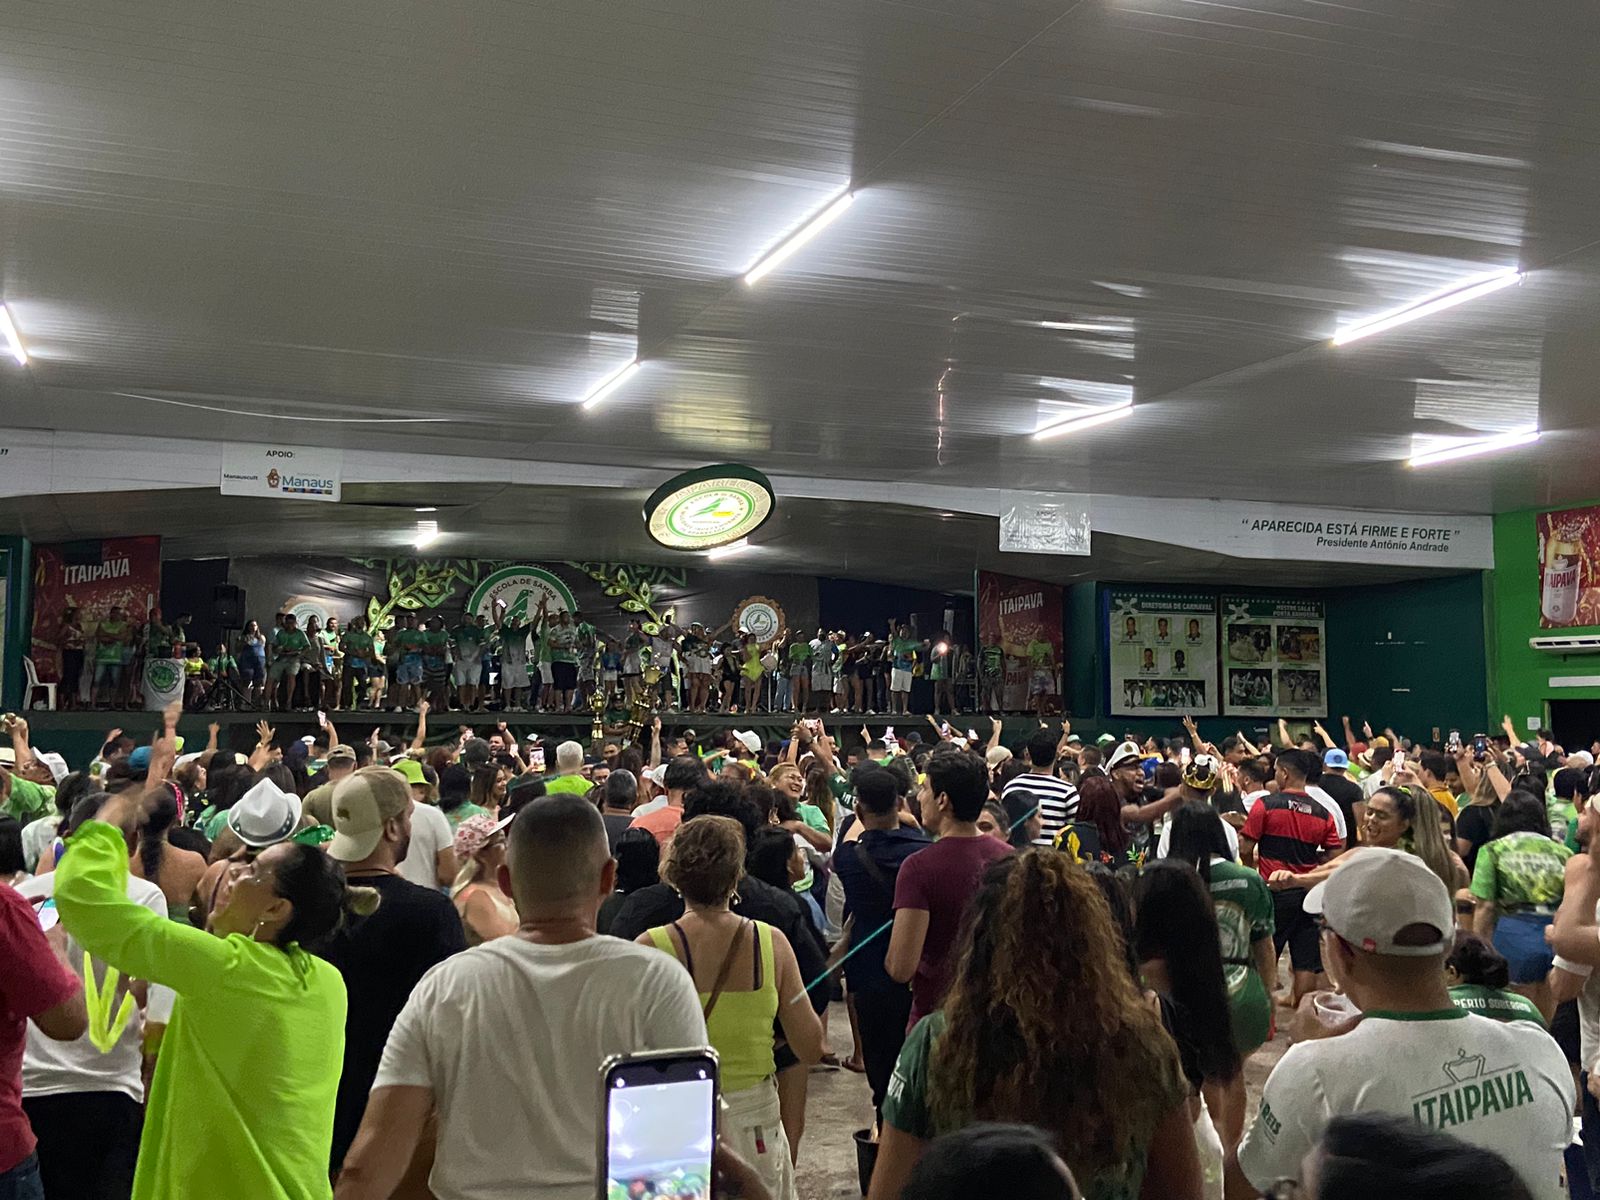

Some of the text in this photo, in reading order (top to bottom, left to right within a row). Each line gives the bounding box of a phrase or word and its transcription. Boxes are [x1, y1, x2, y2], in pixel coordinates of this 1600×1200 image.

[266, 450, 296, 459] APOIO:
[282, 475, 333, 489] Manaus
[1326, 521, 1358, 536] ESTÁ
[1361, 524, 1398, 539] FIRME
[1401, 527, 1409, 539] E
[1316, 536, 1449, 552] Presidente Antônio Andrade
[64, 558, 131, 586] ITAIPAVA
[488, 578, 519, 599] ESCOLA
[532, 580, 557, 601] SAMBA
[1000, 591, 1044, 615] ITAIPAVA
[1412, 1070, 1535, 1129] ITAIPAVA
